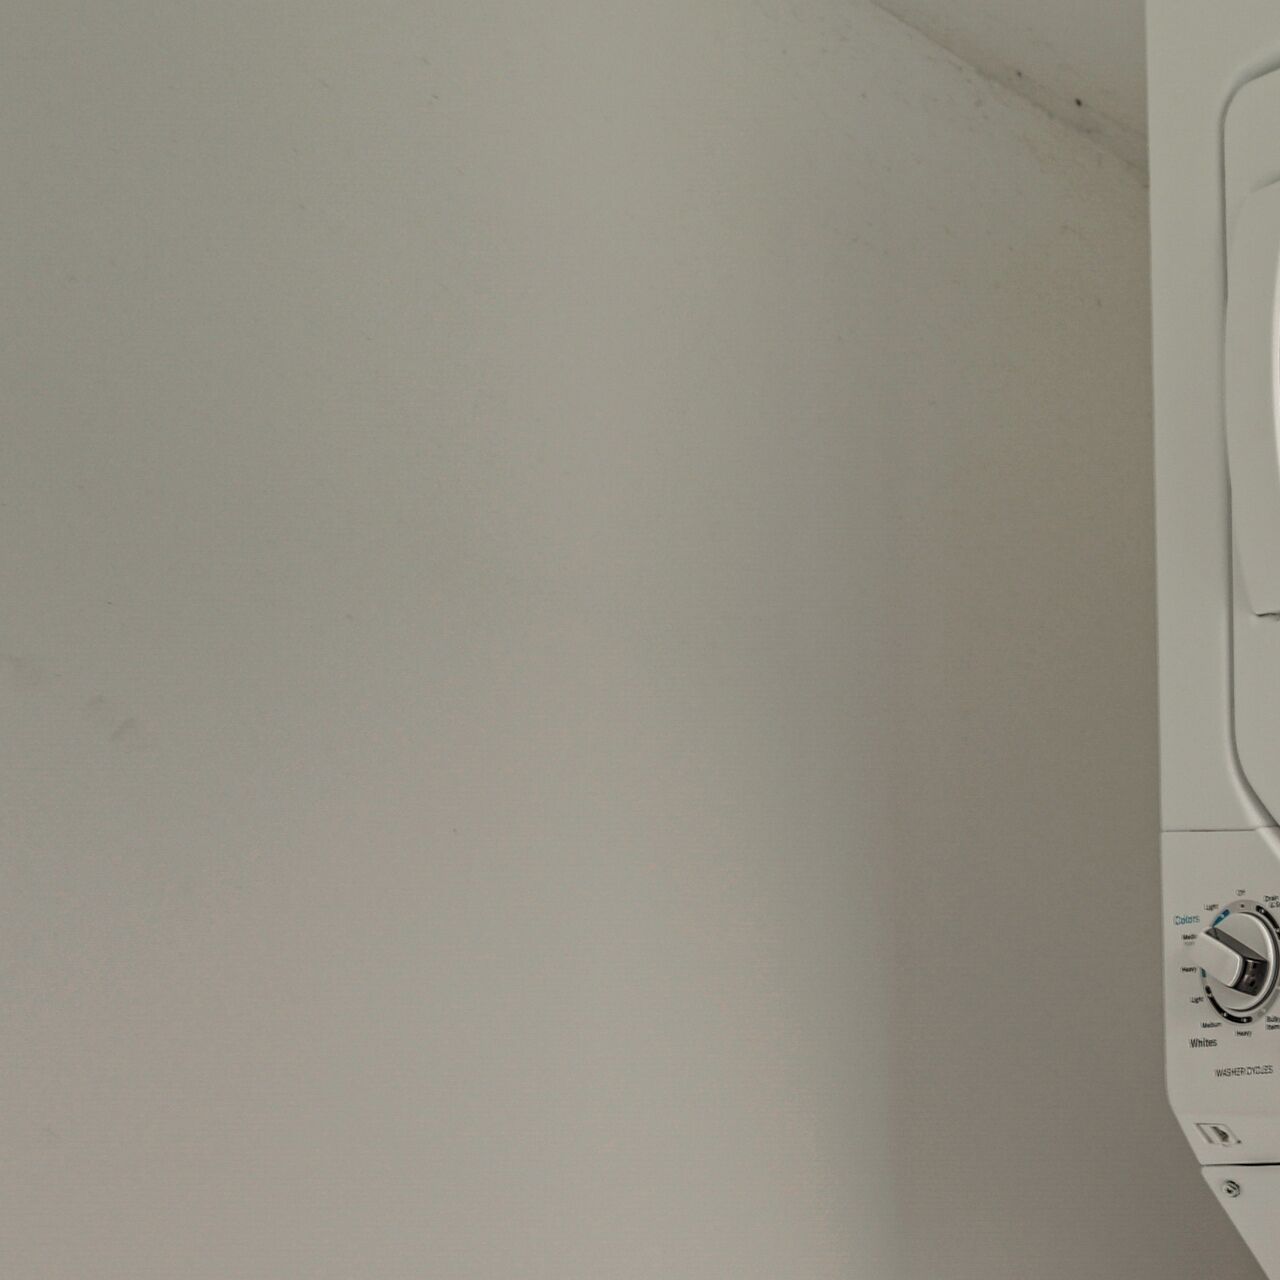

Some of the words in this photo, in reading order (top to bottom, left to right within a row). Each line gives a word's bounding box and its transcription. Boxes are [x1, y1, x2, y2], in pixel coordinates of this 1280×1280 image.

[1174, 915, 1200, 926] Colors
[1190, 1038, 1218, 1049] Whites
[1215, 1067, 1246, 1078] WASHER
[1246, 1065, 1274, 1076] CYCLES
